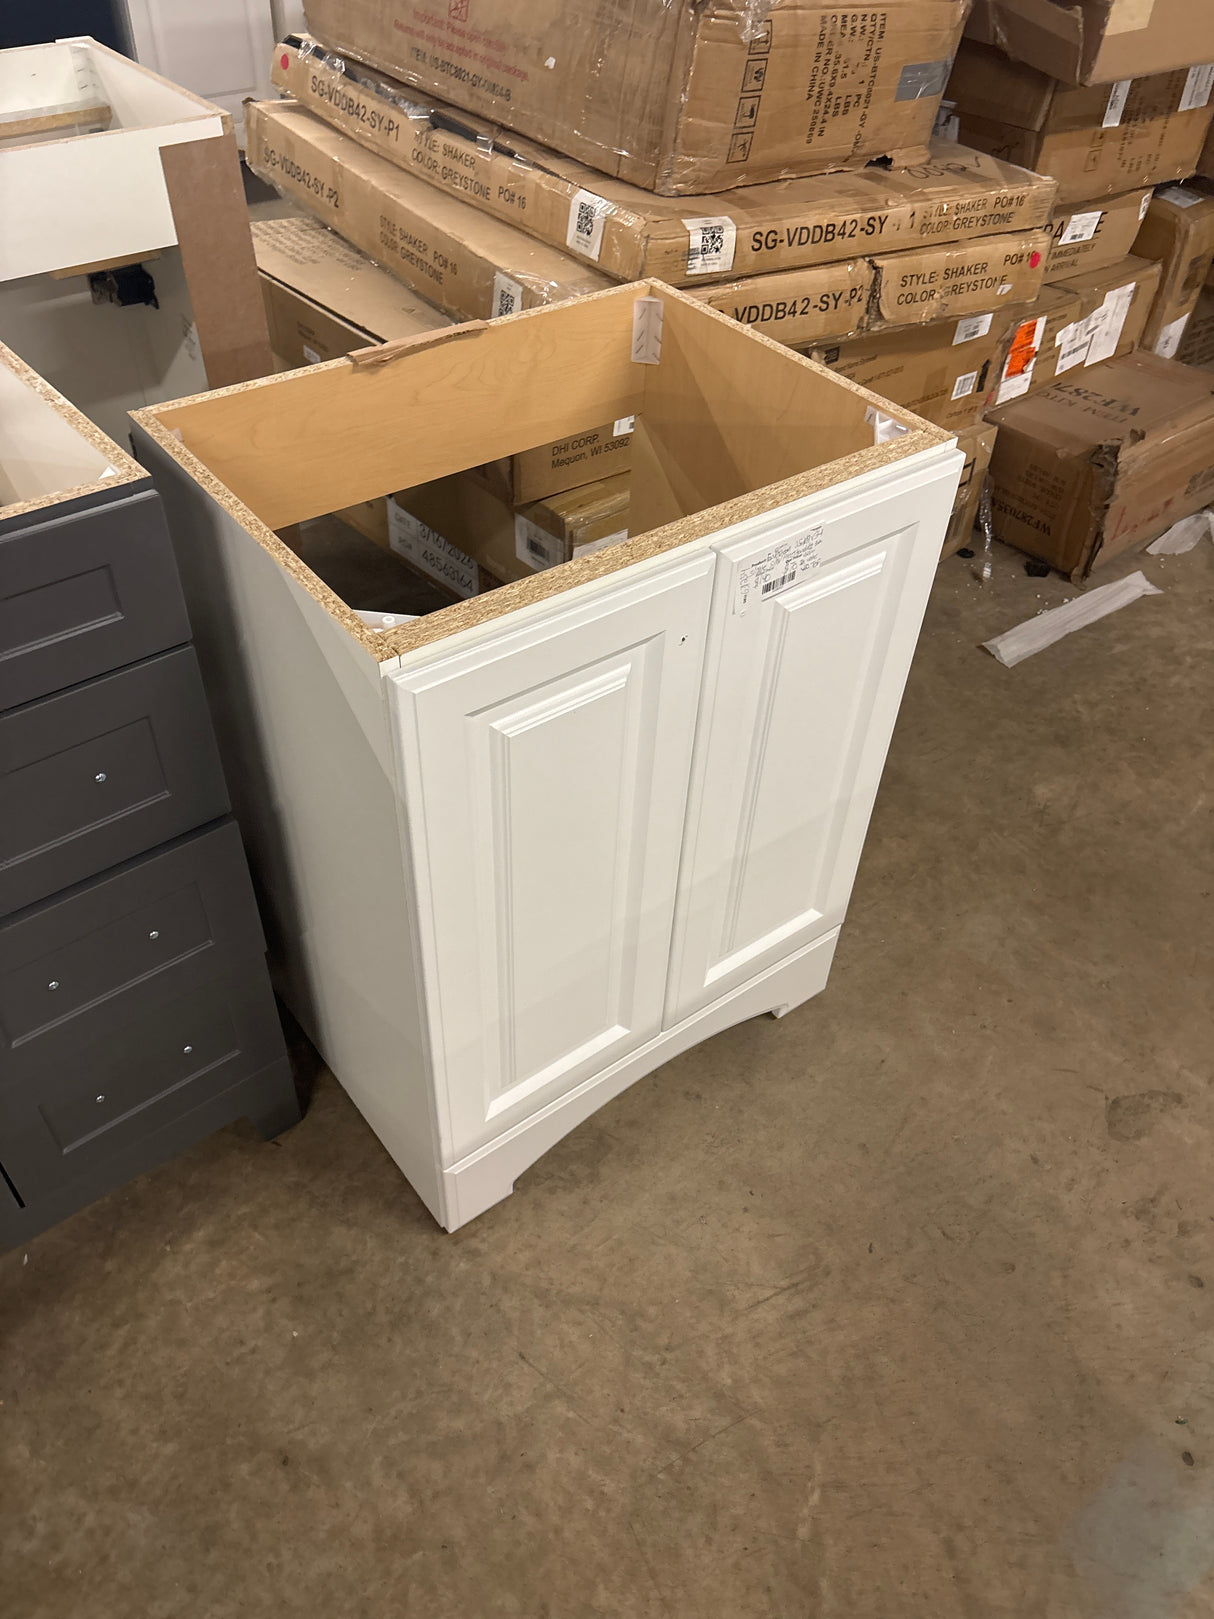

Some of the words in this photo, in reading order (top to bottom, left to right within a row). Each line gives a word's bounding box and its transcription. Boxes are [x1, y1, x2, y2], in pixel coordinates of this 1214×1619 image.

[814, 52, 822, 63] IN
[806, 66, 819, 101] CHINA
[441, 166, 491, 201] GREYSTONE
[954, 198, 988, 216] SHAKER
[952, 211, 1015, 231] GREYSTONE
[400, 246, 443, 285] GREYSTONE
[900, 271, 939, 288] STYLE:
[943, 262, 989, 281] SHAKER
[551, 443, 569, 457] DHI
[571, 434, 600, 450] CORP.
[551, 452, 588, 469] Mequon,
[590, 446, 602, 457] WI
[604, 437, 630, 453] 53092
